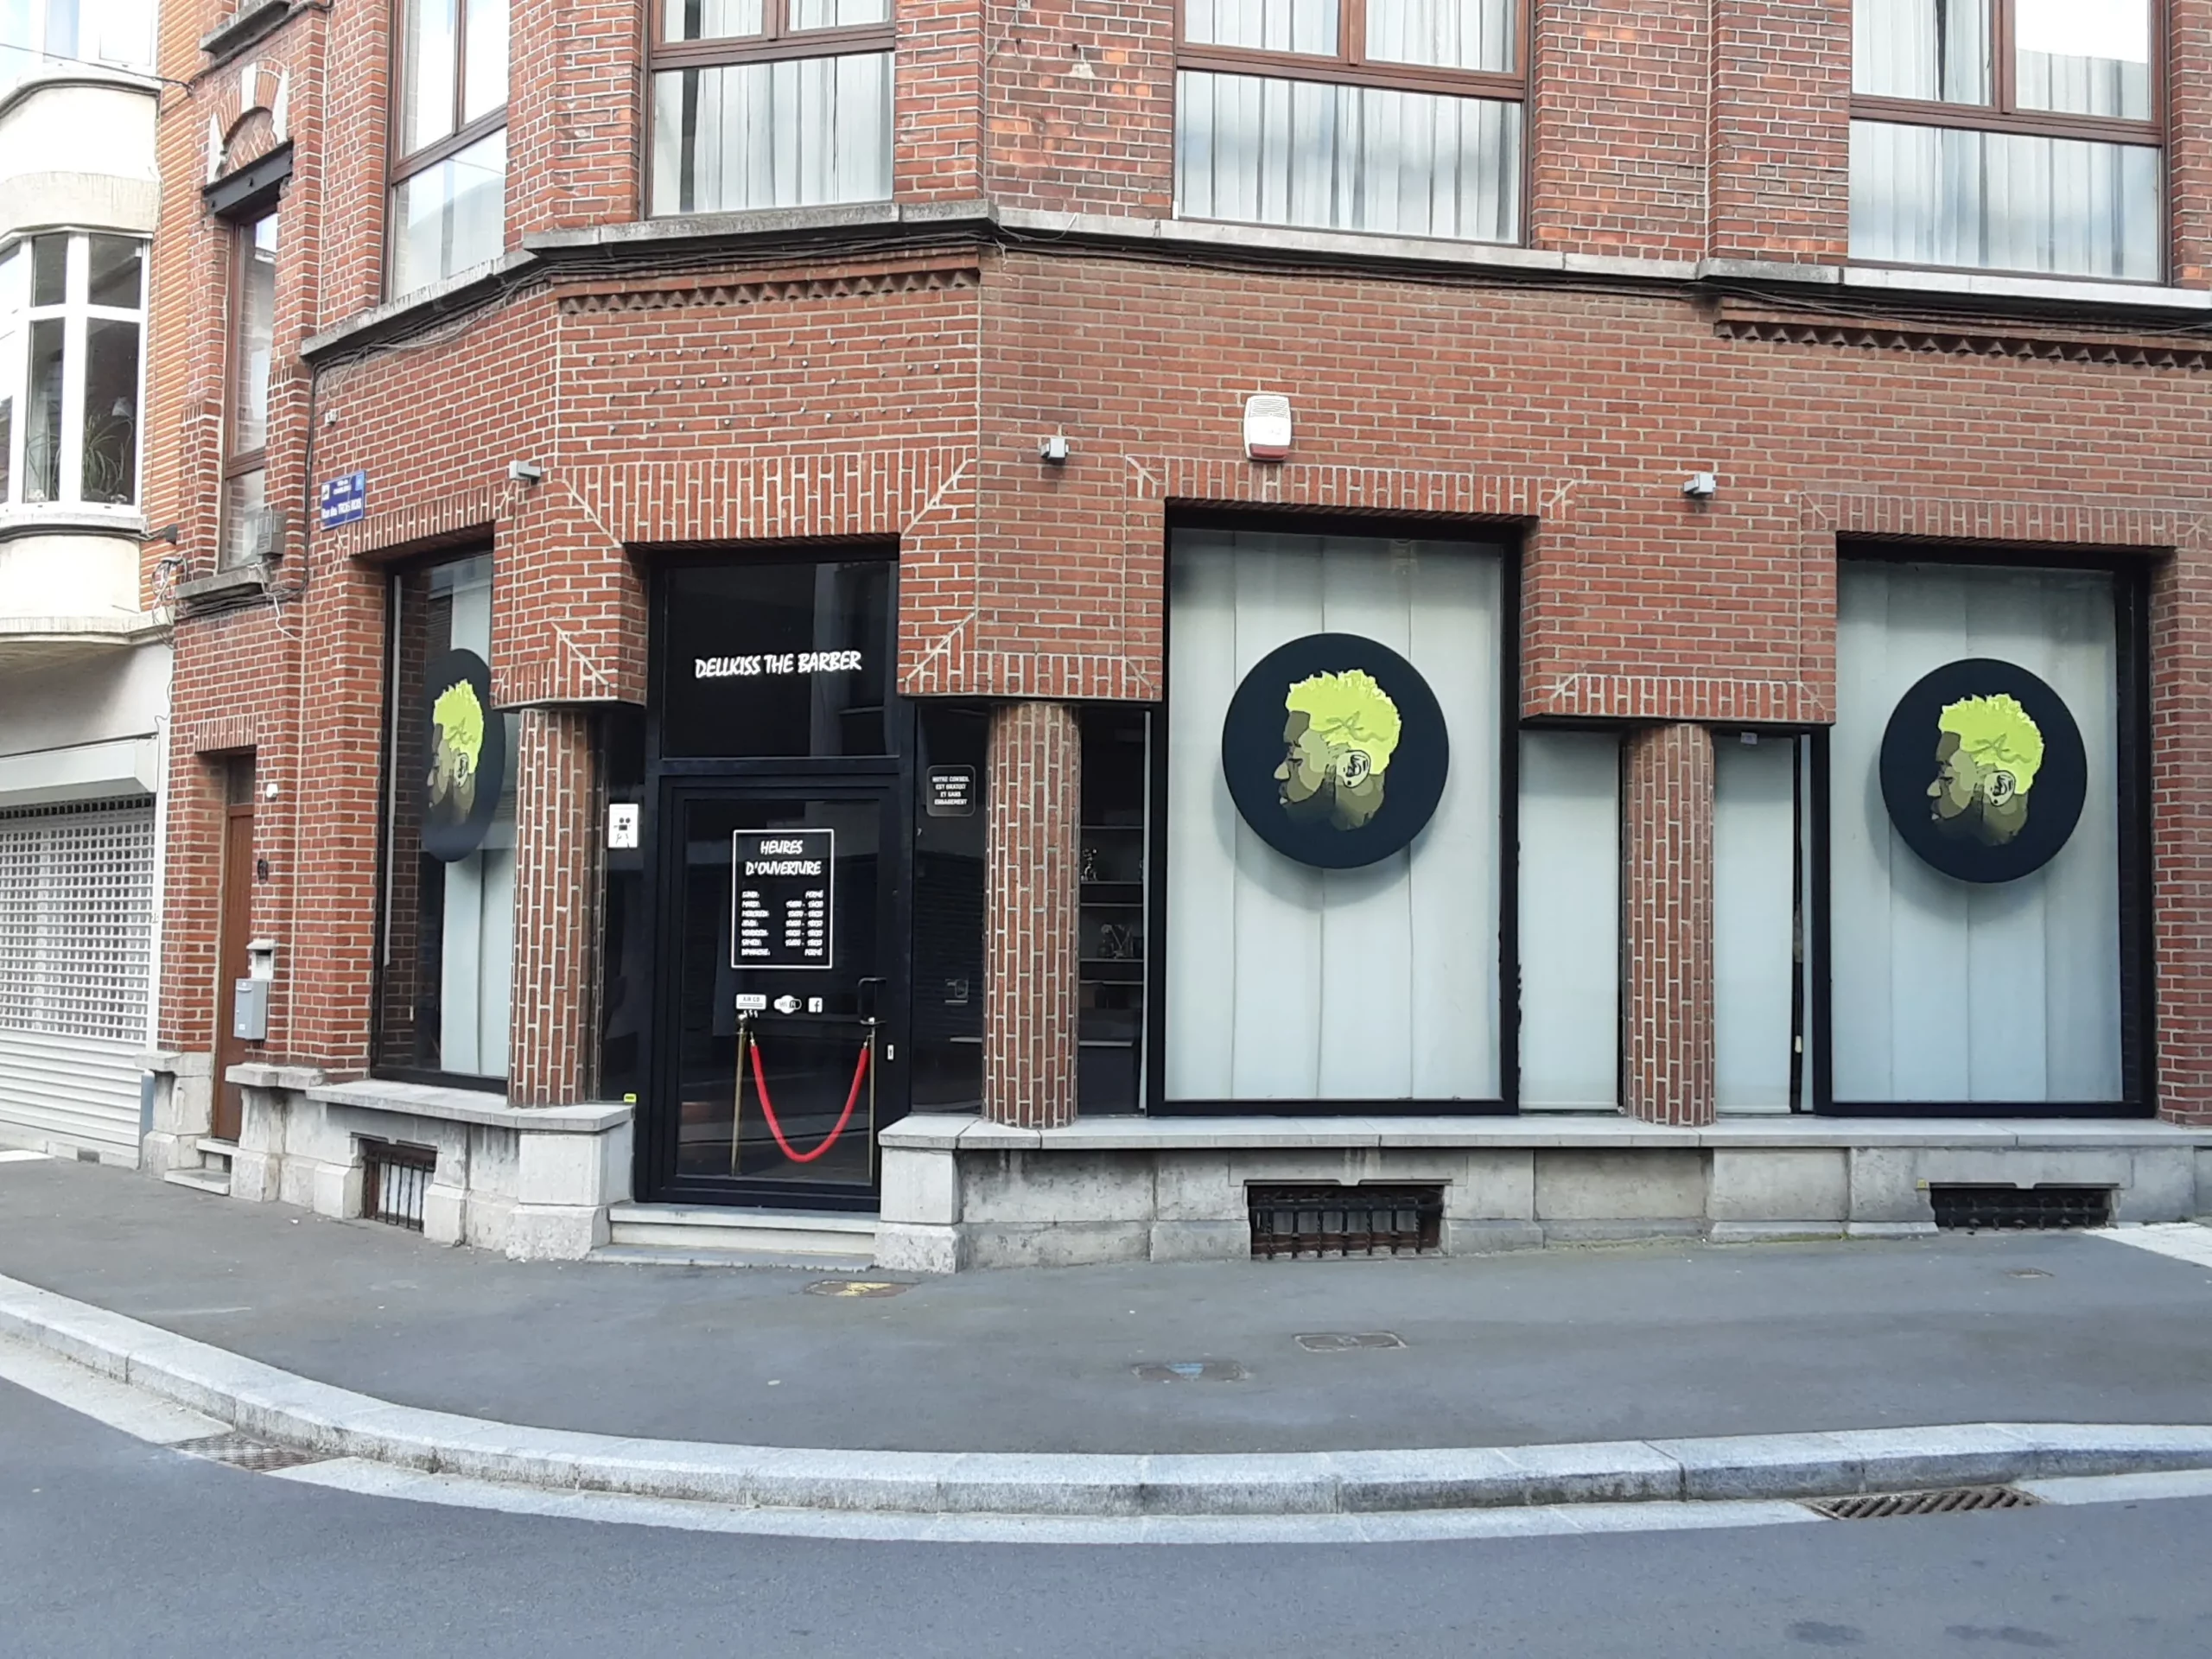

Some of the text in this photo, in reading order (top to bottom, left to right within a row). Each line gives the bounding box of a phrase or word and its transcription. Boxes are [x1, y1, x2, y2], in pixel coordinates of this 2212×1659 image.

[695, 650, 862, 678] DELLKISS THE BARBER
[760, 839, 804, 855] HEURES
[745, 861, 822, 876] D'OUVERTURE
